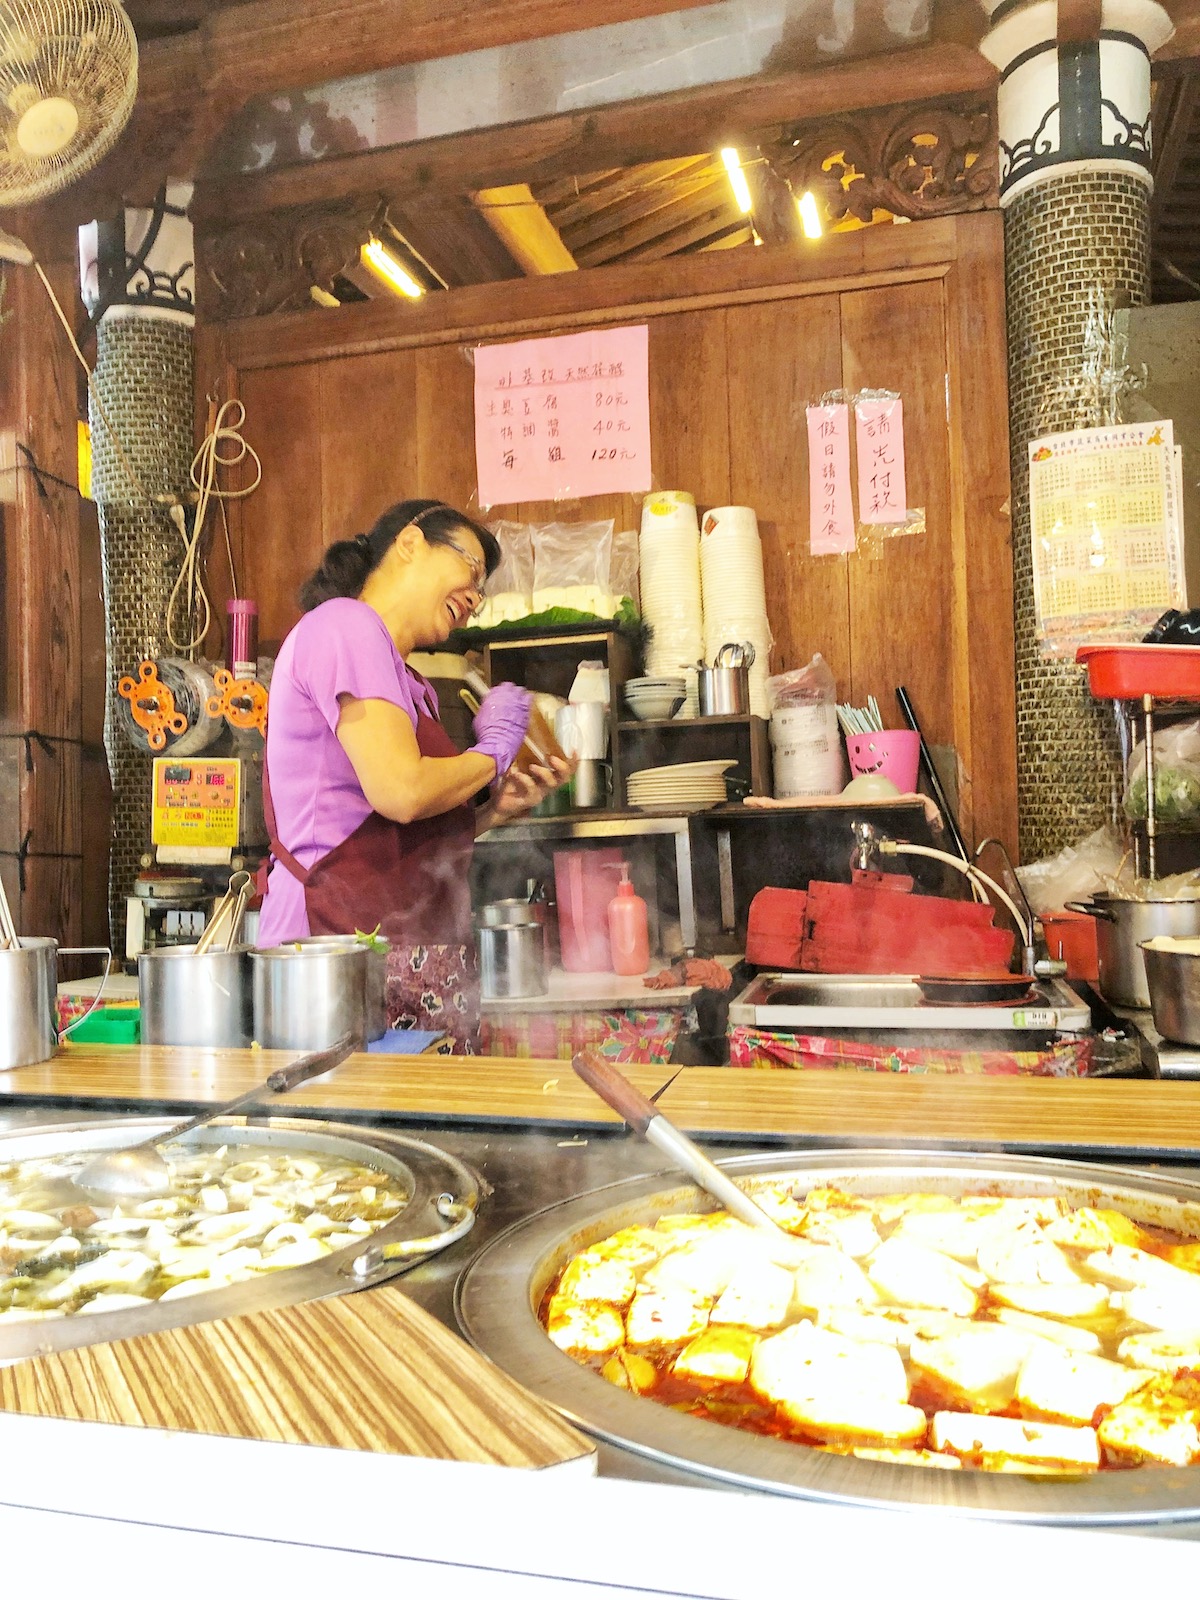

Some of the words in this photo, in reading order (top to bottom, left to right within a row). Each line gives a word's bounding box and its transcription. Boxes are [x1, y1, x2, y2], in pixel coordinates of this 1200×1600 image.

[595, 391, 629, 407] 80元
[592, 419, 632, 435] 40元
[591, 448, 637, 461] 120元
[862, 413, 898, 514] 請先付款
[817, 421, 841, 536] 假日請勿外食
